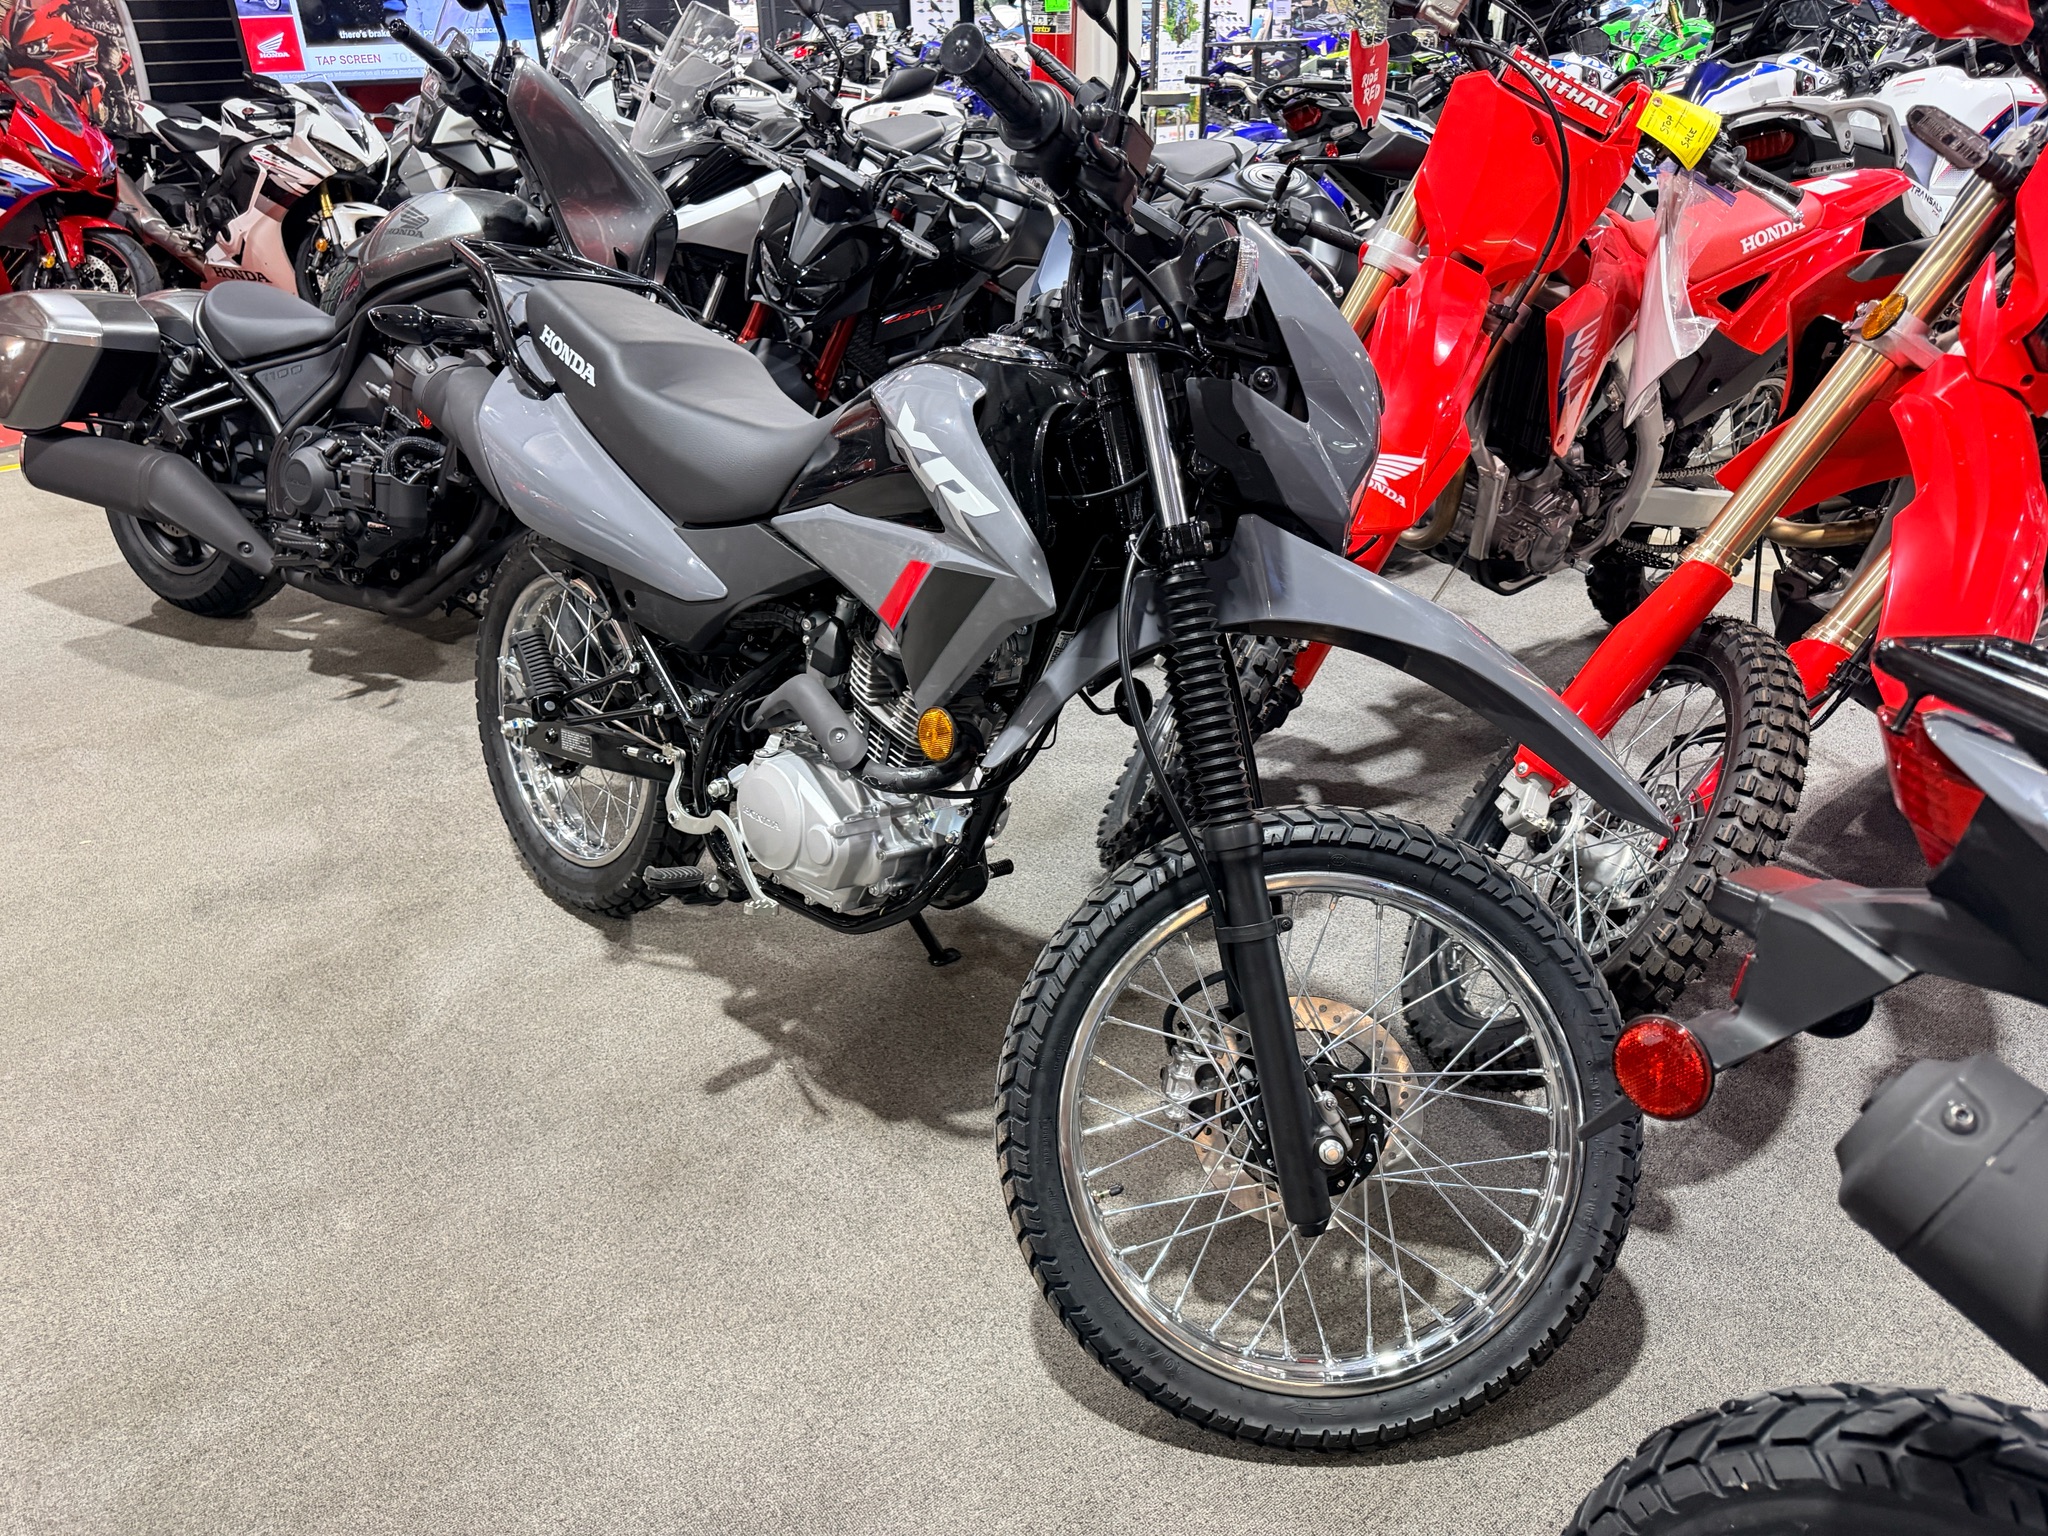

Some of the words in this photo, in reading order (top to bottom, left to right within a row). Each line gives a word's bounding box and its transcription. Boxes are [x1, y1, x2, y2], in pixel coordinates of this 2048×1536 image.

[339, 29, 367, 39] there's
[315, 56, 336, 66] TAP
[339, 54, 381, 64] SCREEN
[1361, 68, 1380, 88] RIDE
[1363, 83, 1381, 107] RED
[1660, 115, 1674, 135] STOP
[1681, 127, 1697, 148] SALE
[386, 227, 424, 239] HONDA
[1740, 220, 1806, 254] HONDA
[212, 266, 272, 284] HONDA
[539, 324, 596, 387] HONDA
[260, 364, 304, 383] 1100
